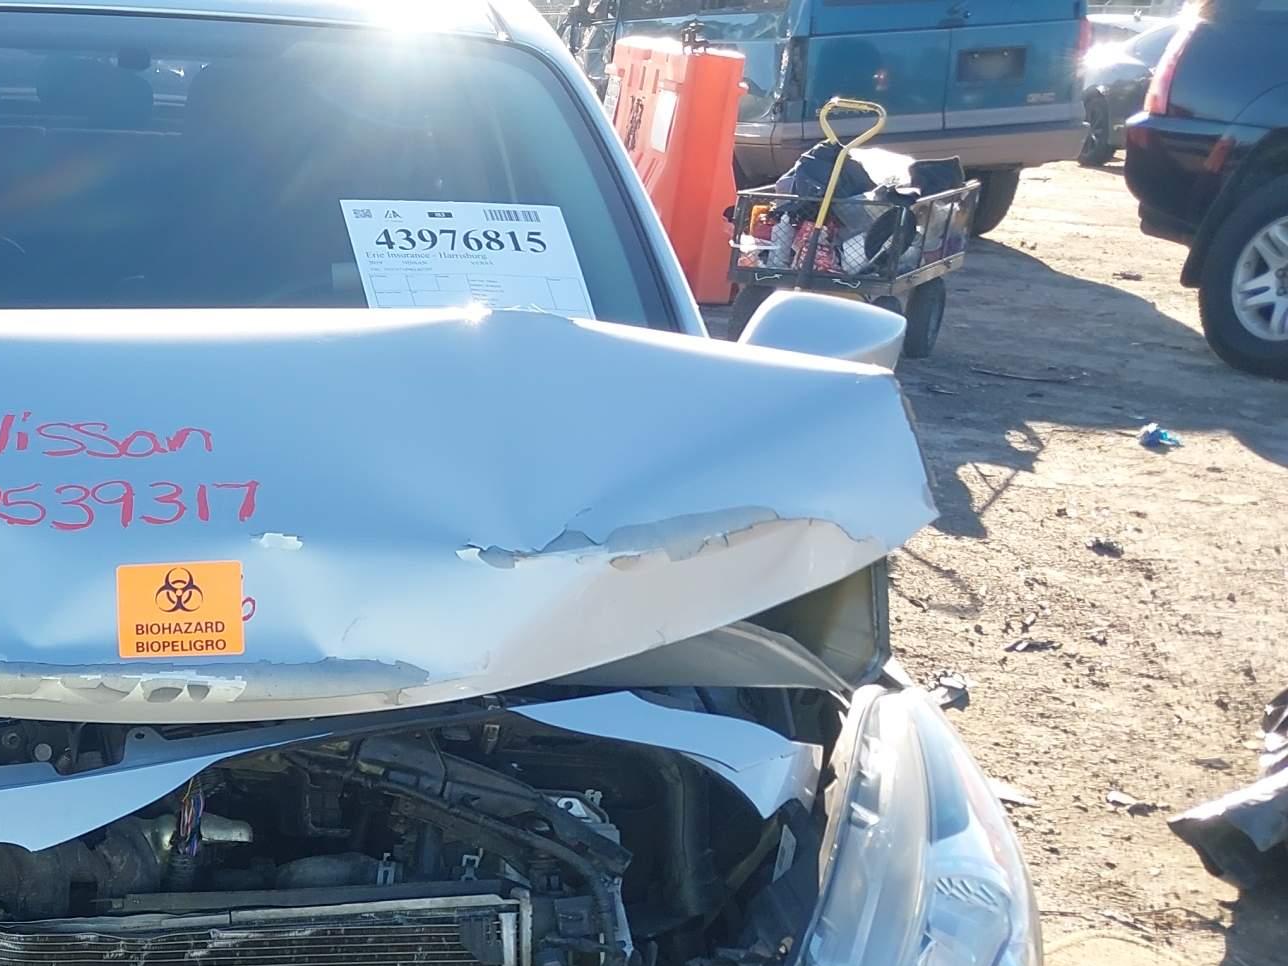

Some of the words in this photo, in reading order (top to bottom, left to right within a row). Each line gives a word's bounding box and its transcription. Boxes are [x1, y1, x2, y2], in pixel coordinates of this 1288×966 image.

[375, 228, 547, 253] 43976815
[135, 620, 226, 636] BIOHAZARD
[135, 639, 228, 653] BIOPELIGRO
